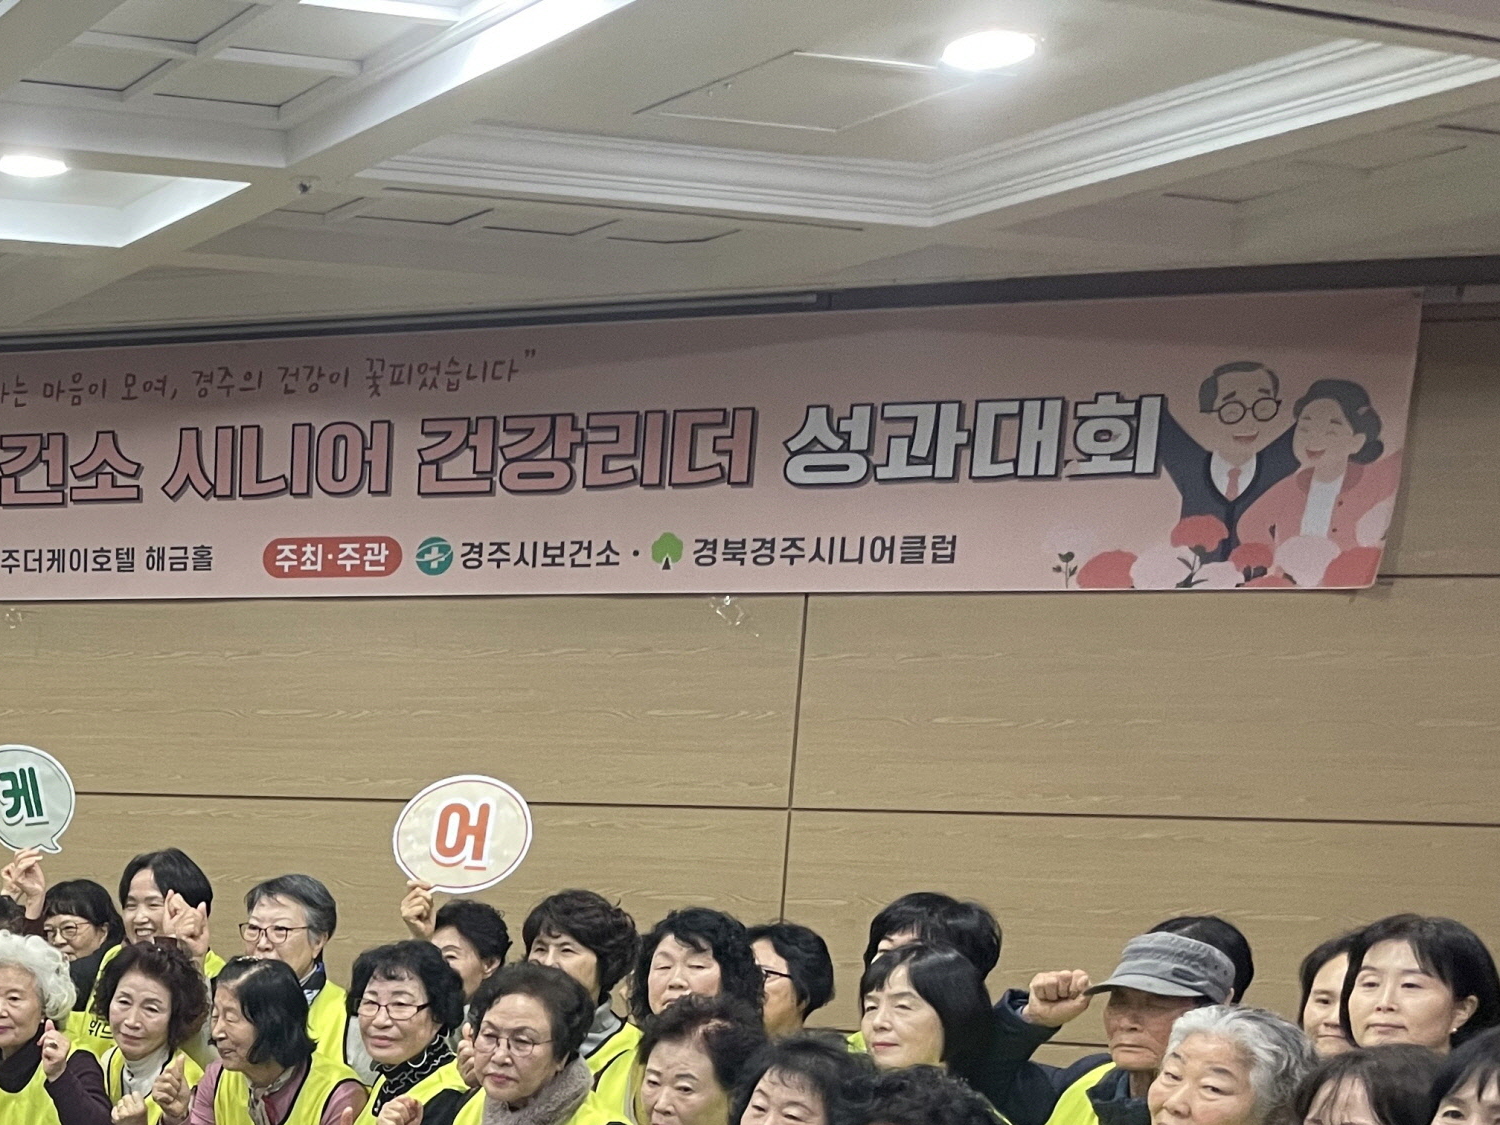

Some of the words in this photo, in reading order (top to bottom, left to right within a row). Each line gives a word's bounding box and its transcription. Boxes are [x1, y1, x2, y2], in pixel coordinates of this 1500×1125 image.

[42, 371, 107, 407] 마음이
[120, 372, 179, 402] 모여,
[191, 365, 263, 399] 경주의
[277, 366, 350, 395] 건강이
[161, 419, 394, 503] 시니어
[417, 405, 758, 497] 건강리더
[782, 392, 1168, 490] 성과대회
[145, 544, 214, 572] 해금홀
[460, 538, 621, 570] 경주시보건소
[691, 533, 958, 567] 경북경주시니어클럽
[432, 801, 490, 862] 어
